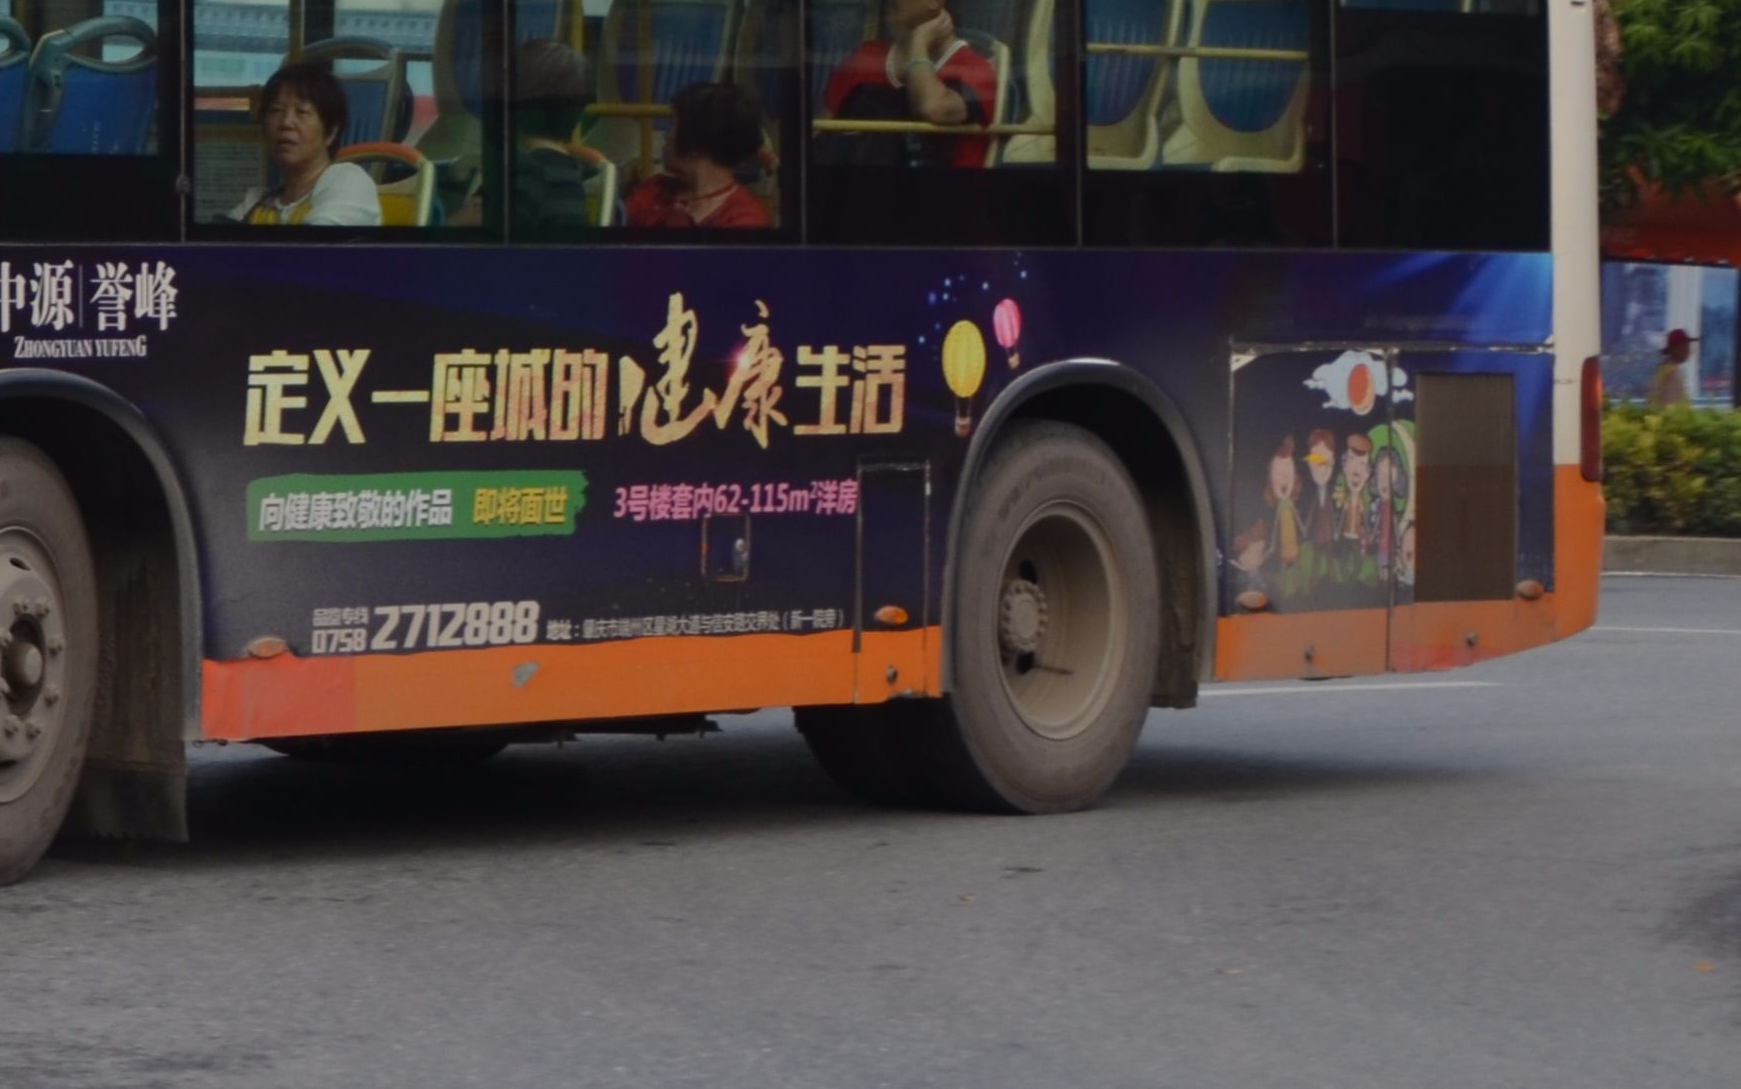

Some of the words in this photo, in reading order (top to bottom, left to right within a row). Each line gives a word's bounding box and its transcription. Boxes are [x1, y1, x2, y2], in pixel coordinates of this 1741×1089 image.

[13, 335, 93, 359] ZHONGYUAN
[95, 335, 147, 358] YUFENG
[243, 292, 906, 449] 定义一座城的健康生活
[258, 488, 453, 532] 向健康致敬的作品
[472, 486, 568, 525] 即将面世
[311, 628, 368, 654] 0758
[371, 600, 540, 650] 2712888
